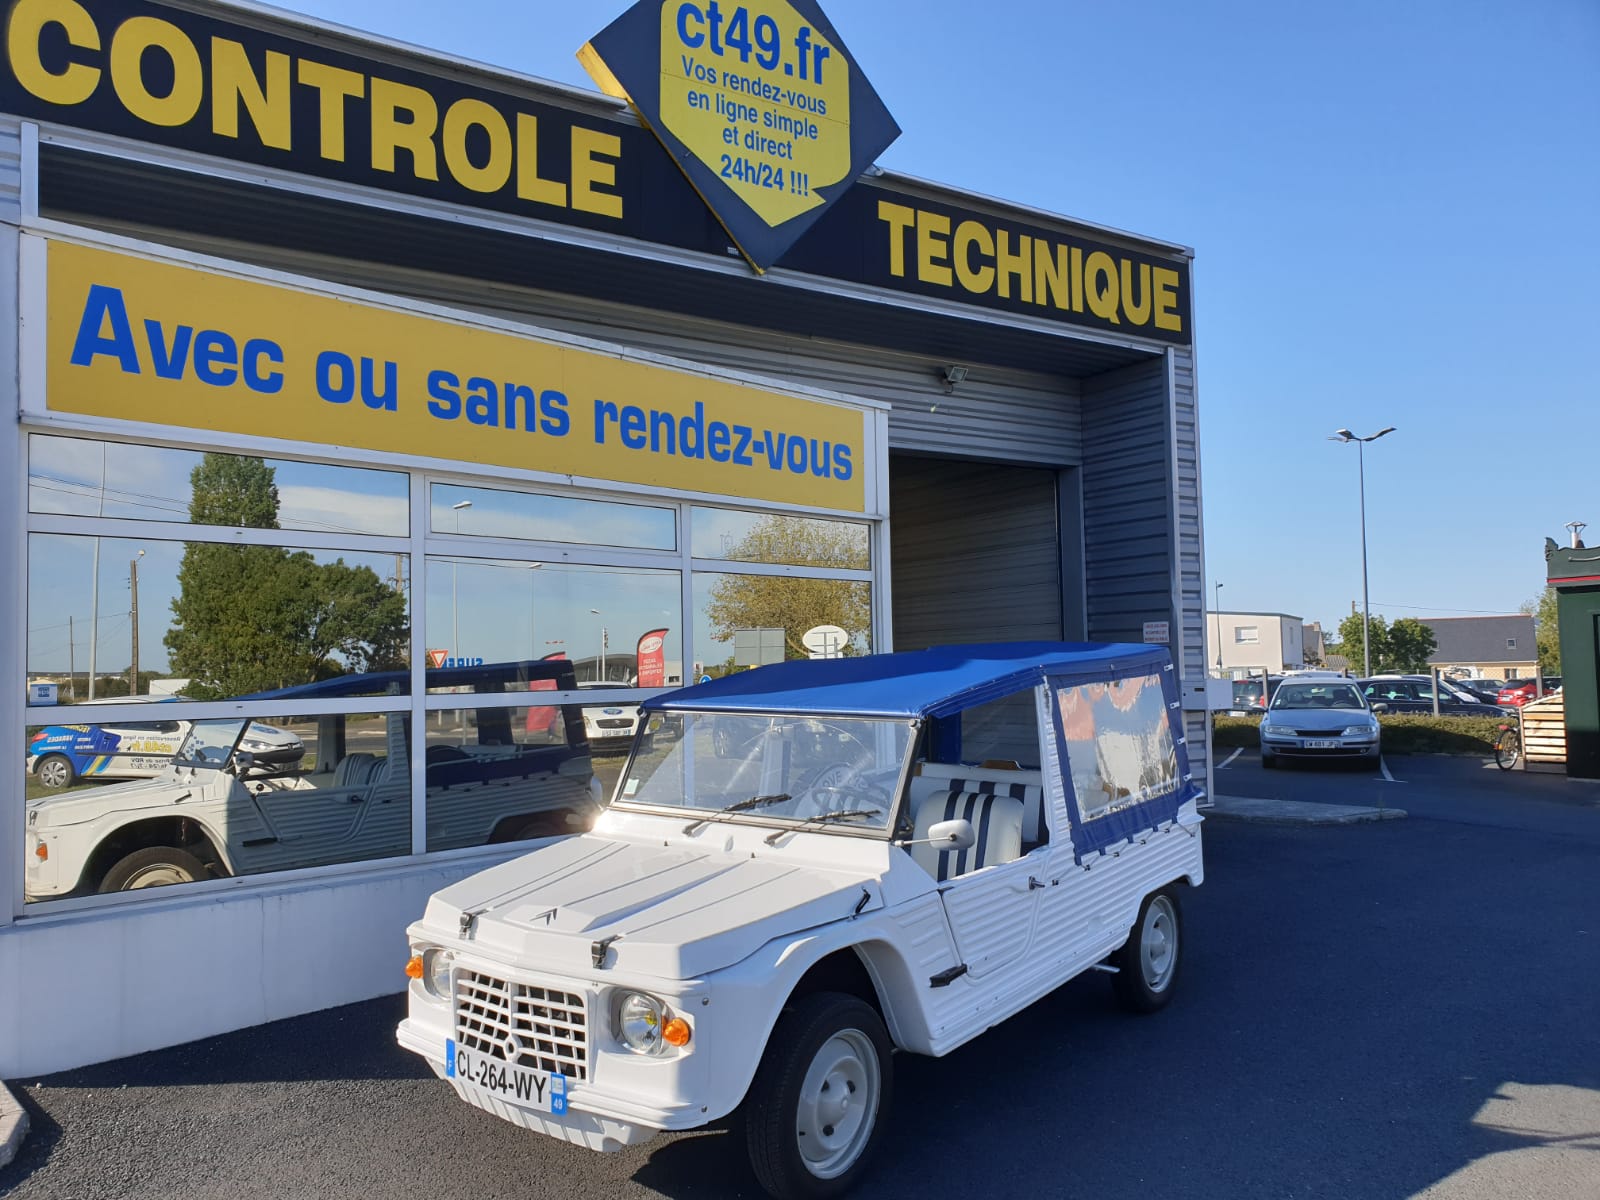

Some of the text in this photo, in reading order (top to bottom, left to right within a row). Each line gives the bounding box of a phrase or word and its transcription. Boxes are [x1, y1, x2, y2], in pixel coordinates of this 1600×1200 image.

[677, 0, 830, 85] ct49.fr
[8, 0, 623, 219] CONTROLE
[682, 55, 826, 115] Vos rendez-vous
[687, 90, 818, 140] en ligne simple
[722, 126, 793, 160] et direct
[720, 153, 809, 197] 24h/24 !!!
[878, 201, 1182, 332] TECHNIQUE
[70, 283, 853, 482] Avec ou sans rendez-vous
[457, 1050, 547, 1104] CL-264-WY
[553, 1098, 564, 1111] 49
